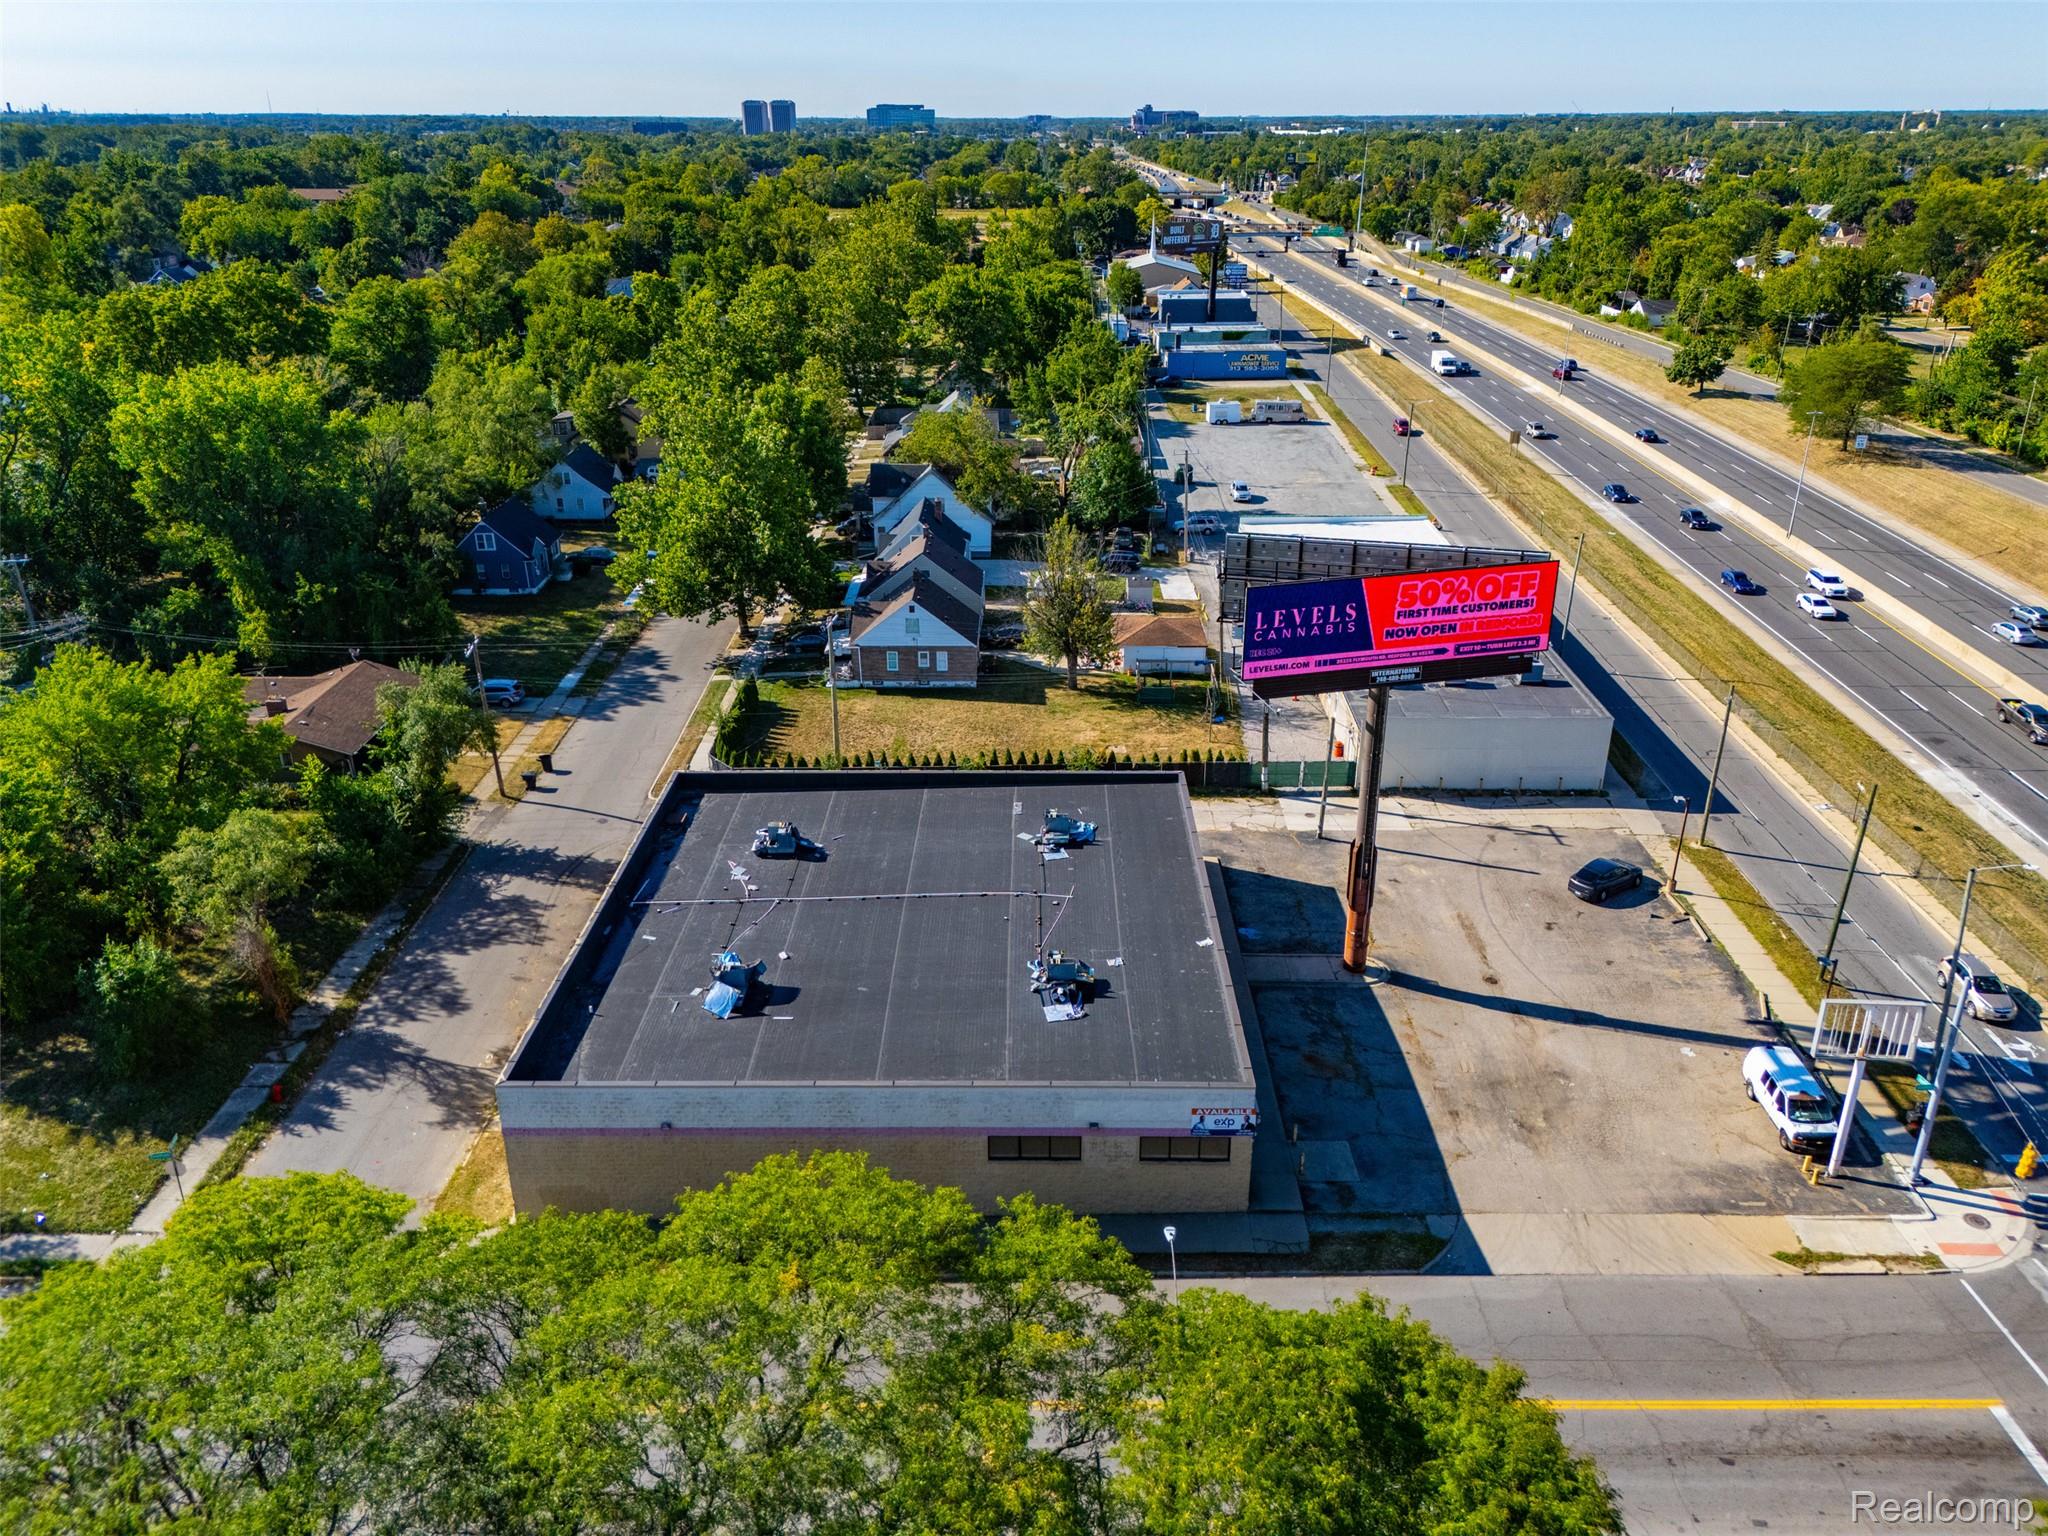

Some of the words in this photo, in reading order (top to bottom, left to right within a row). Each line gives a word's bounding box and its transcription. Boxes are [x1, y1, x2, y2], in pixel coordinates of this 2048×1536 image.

[1170, 225, 1185, 234] BUILT
[1163, 235, 1191, 245] DIFFERENT
[1397, 576, 1473, 608] 50%
[1475, 571, 1540, 602] OFF
[1396, 608, 1431, 620] FIRST
[1431, 605, 1458, 616] TIME
[1460, 598, 1535, 614] CUSTOMERS!
[1255, 603, 1357, 630] LEVELS
[1254, 622, 1355, 641] CANNABIS
[1385, 627, 1418, 639] NOW
[1421, 623, 1457, 636] OPEN
[1249, 661, 1310, 674] LEVELSMI.COM
[1371, 666, 1420, 677] INTERNATIONAL
[1214, 1117, 1235, 1128] exp
